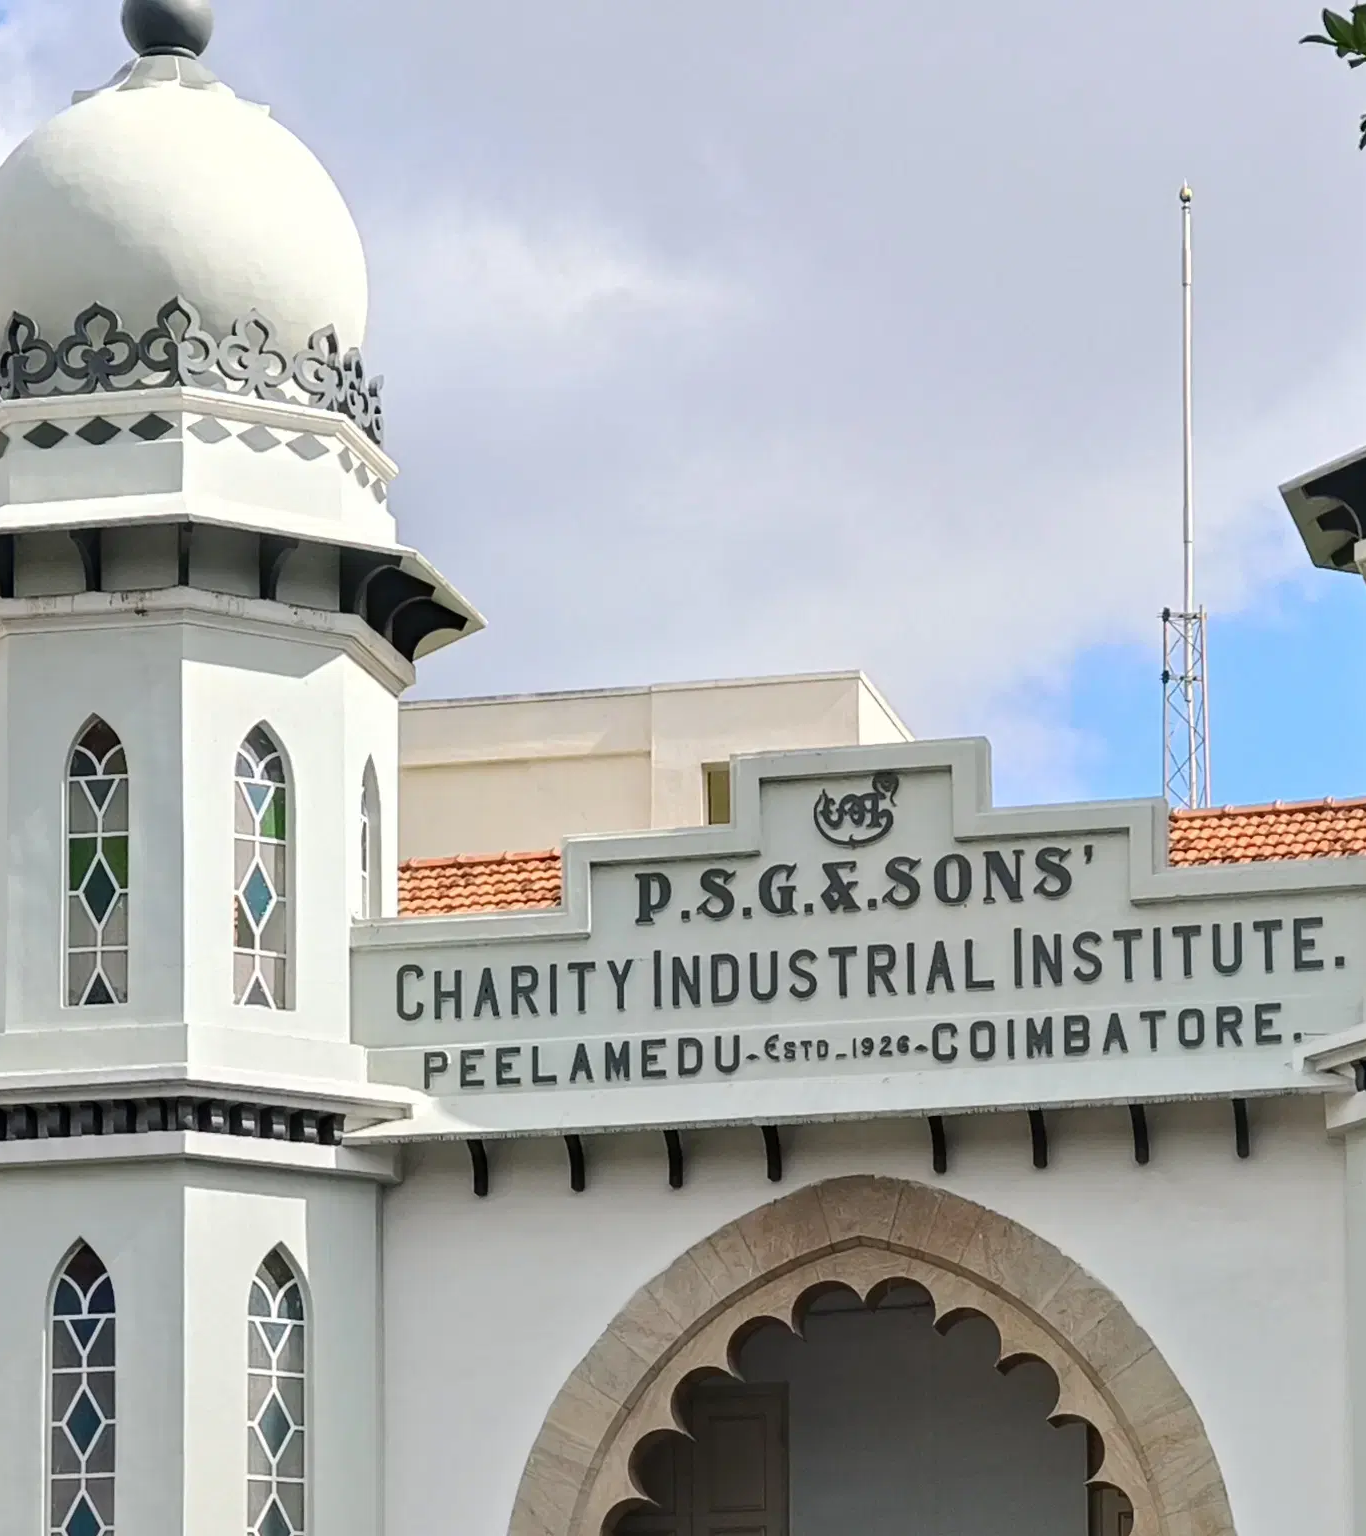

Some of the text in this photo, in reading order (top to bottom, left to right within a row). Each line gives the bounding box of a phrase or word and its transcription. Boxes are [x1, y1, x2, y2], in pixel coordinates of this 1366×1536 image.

[395, 916, 1345, 1022] CHARITY INDUSTRIAL INSTITUTE.
